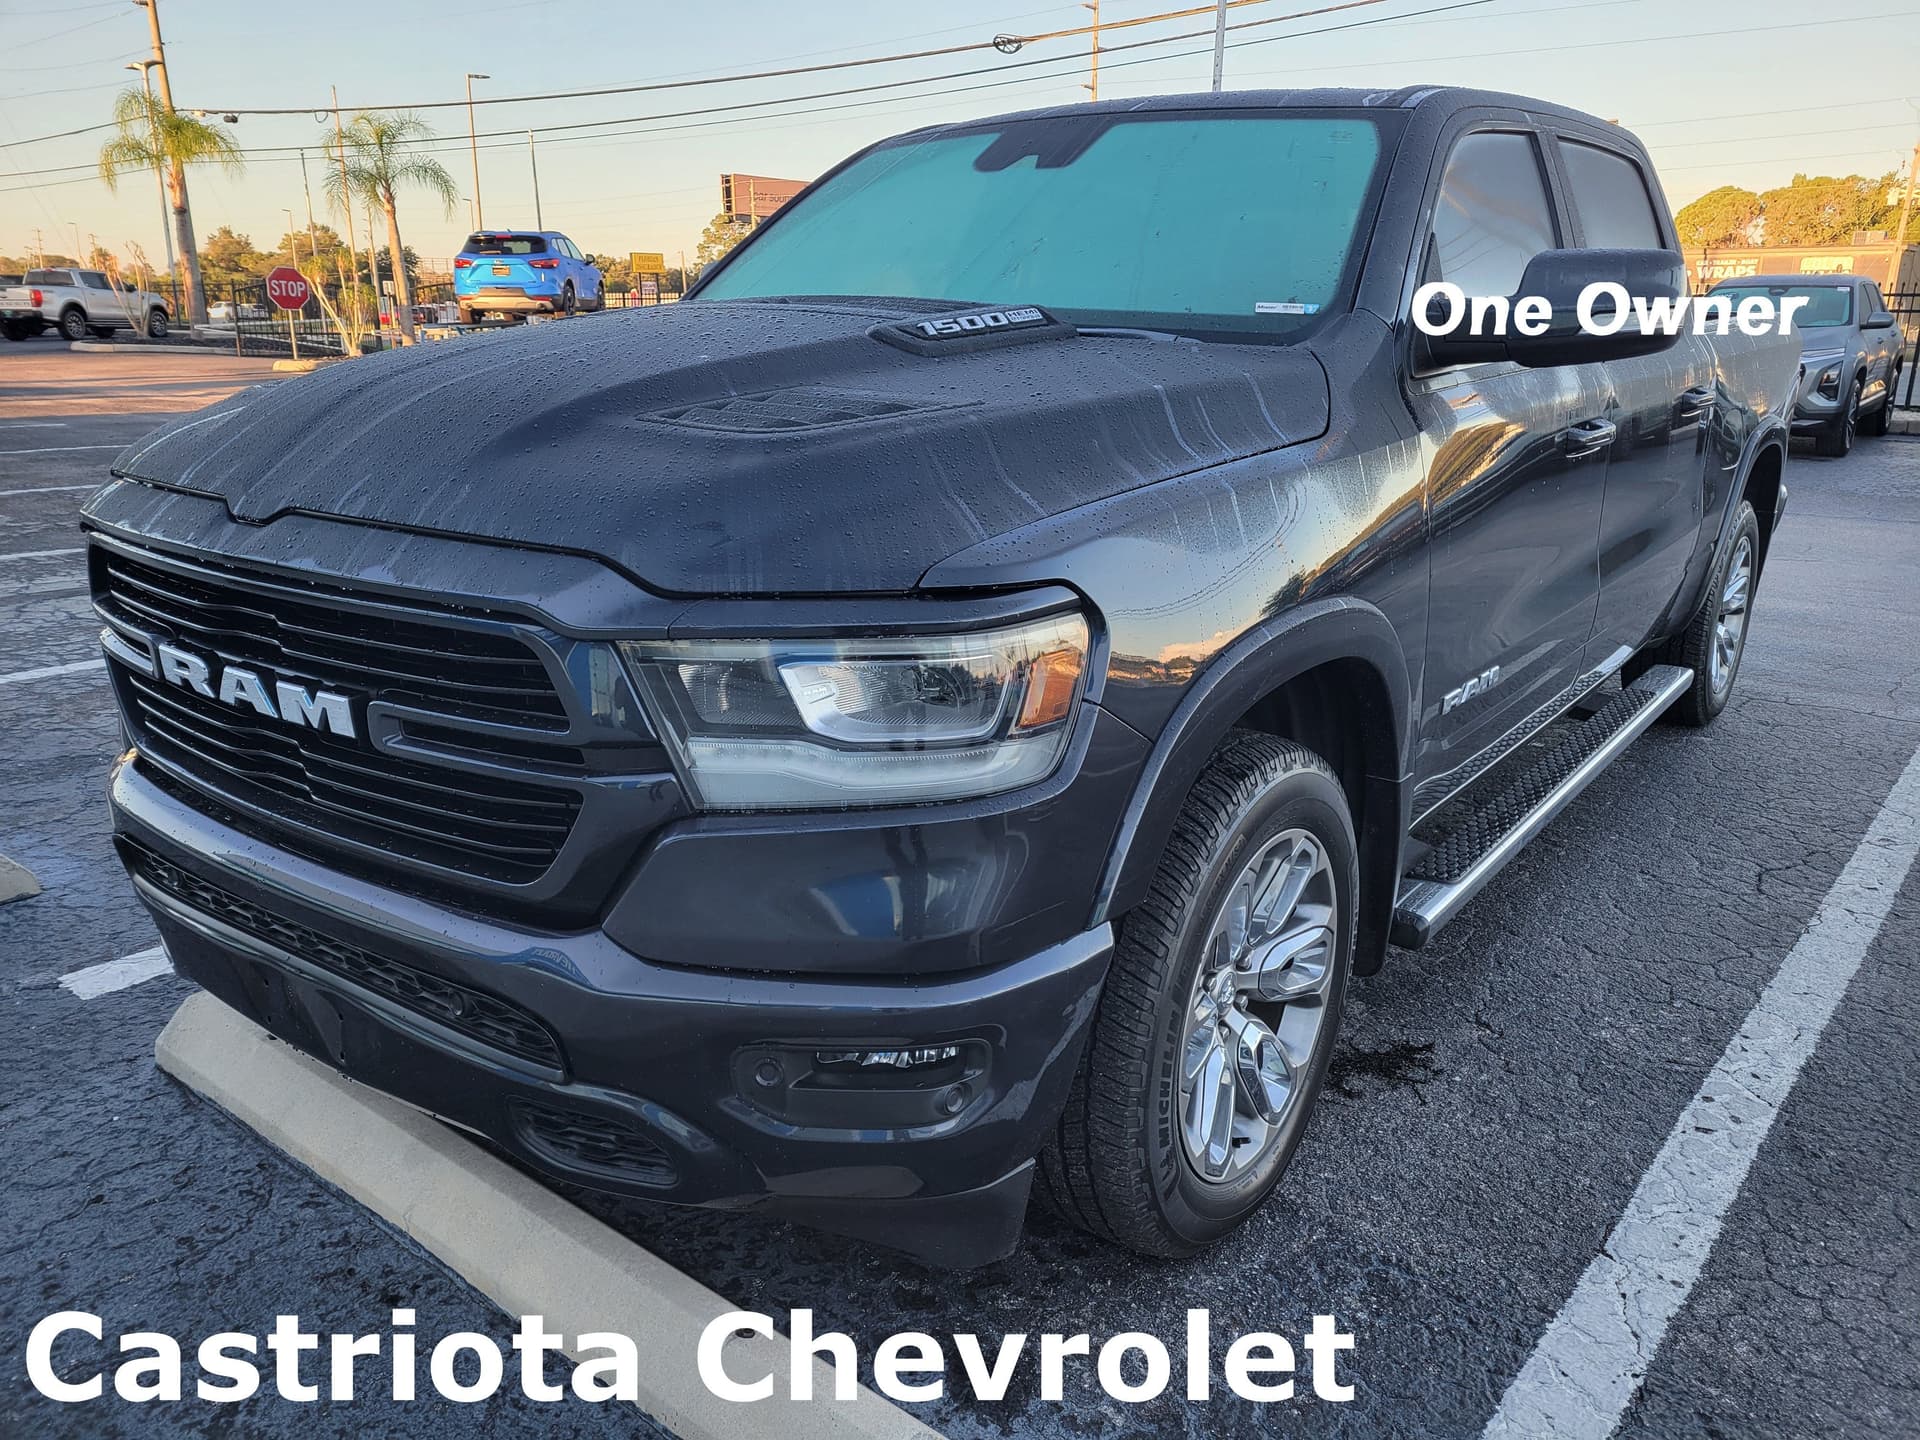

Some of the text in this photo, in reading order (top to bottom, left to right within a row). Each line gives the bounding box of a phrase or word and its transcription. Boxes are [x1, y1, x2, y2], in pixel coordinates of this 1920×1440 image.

[271, 280, 305, 297] STOP
[1696, 265, 1757, 279] WRAPS
[917, 312, 1009, 336] 1500
[158, 643, 357, 739] RAM
[1441, 665, 1500, 715] RAM
[1158, 1008, 1182, 1150] MICHELIN
